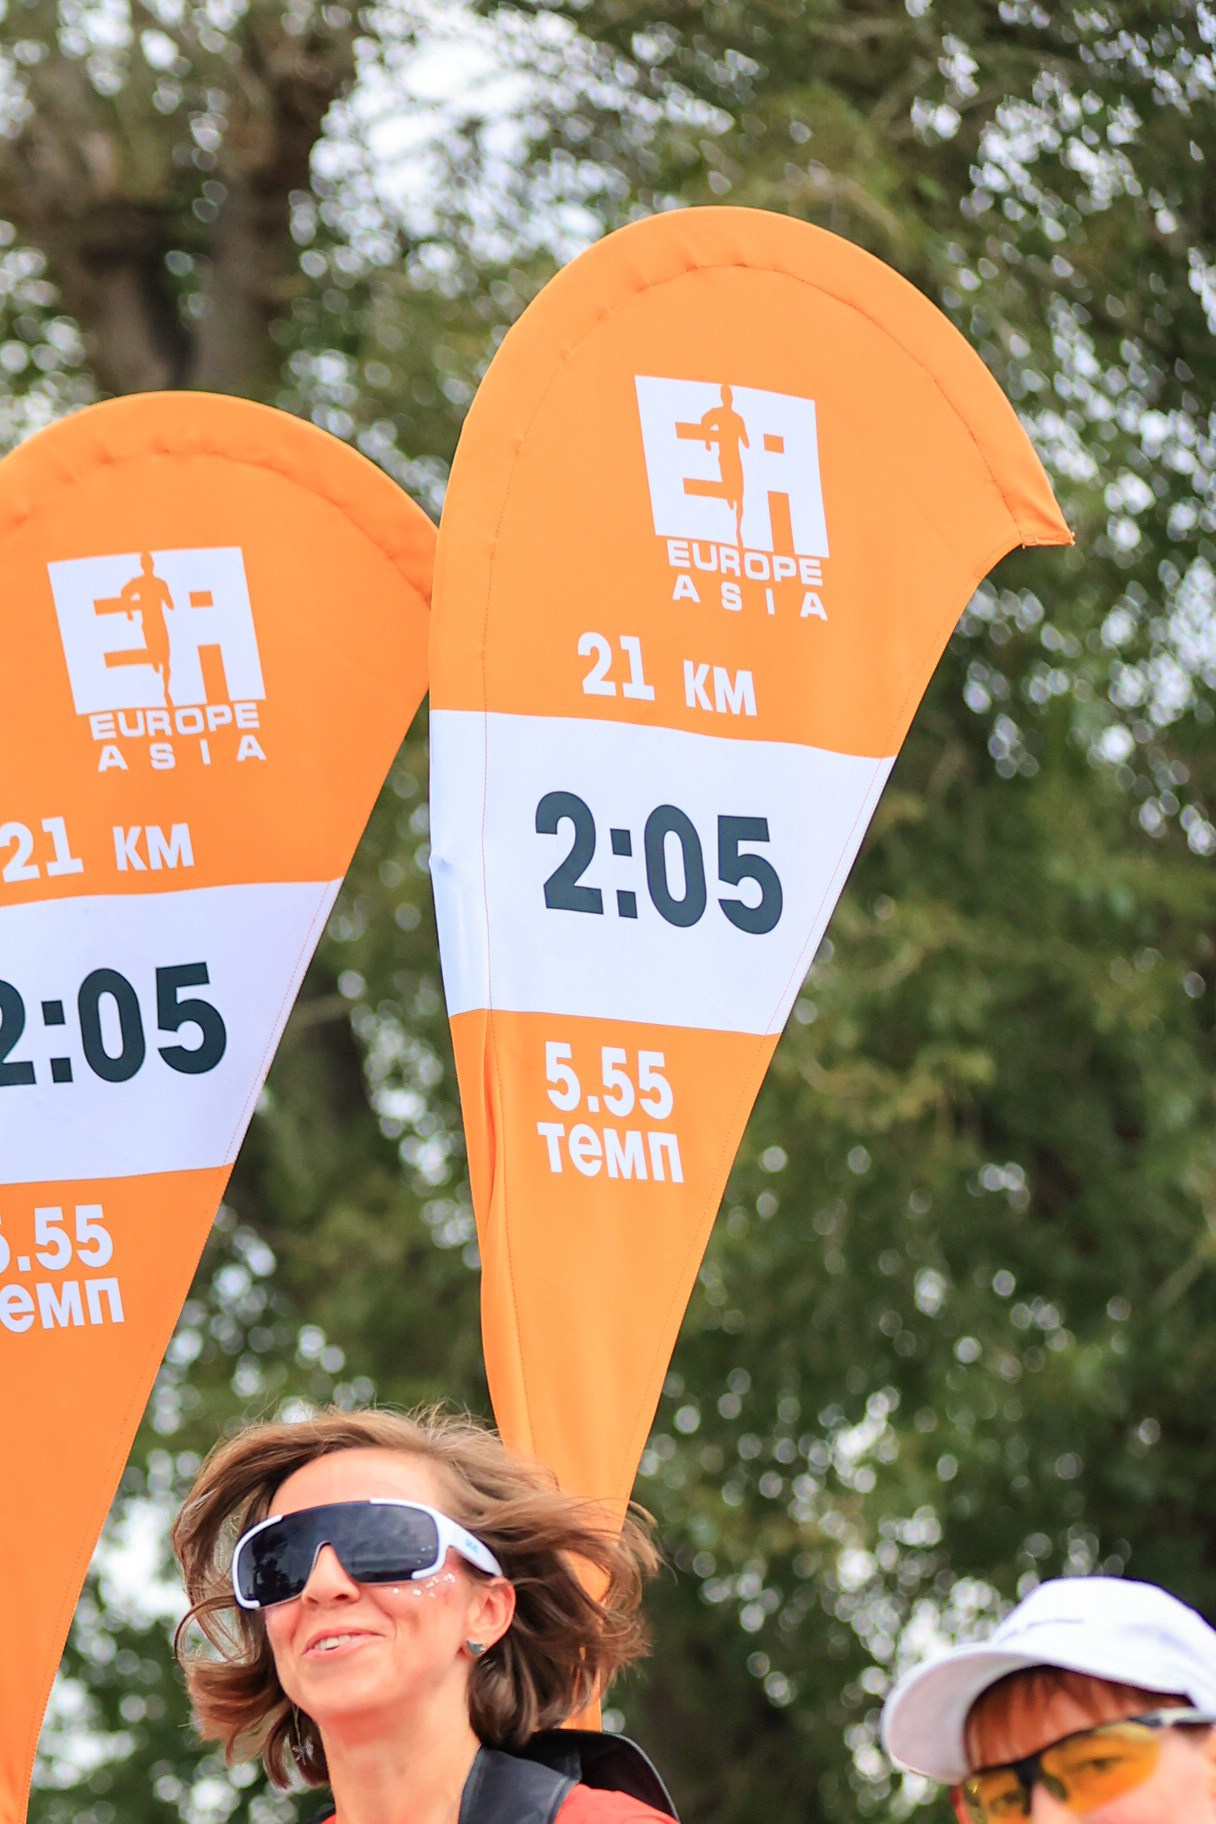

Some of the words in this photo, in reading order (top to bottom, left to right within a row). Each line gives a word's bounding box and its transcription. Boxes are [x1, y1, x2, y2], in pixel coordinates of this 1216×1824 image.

[667, 539, 823, 587] EUROPE
[672, 574, 828, 621] ASIA
[577, 631, 656, 702] 21
[88, 702, 260, 741] EUROPE
[97, 734, 267, 772] ASIA
[535, 791, 783, 935] 2:05
[544, 1040, 674, 1119] 5.55
[536, 1121, 684, 1184] темп
